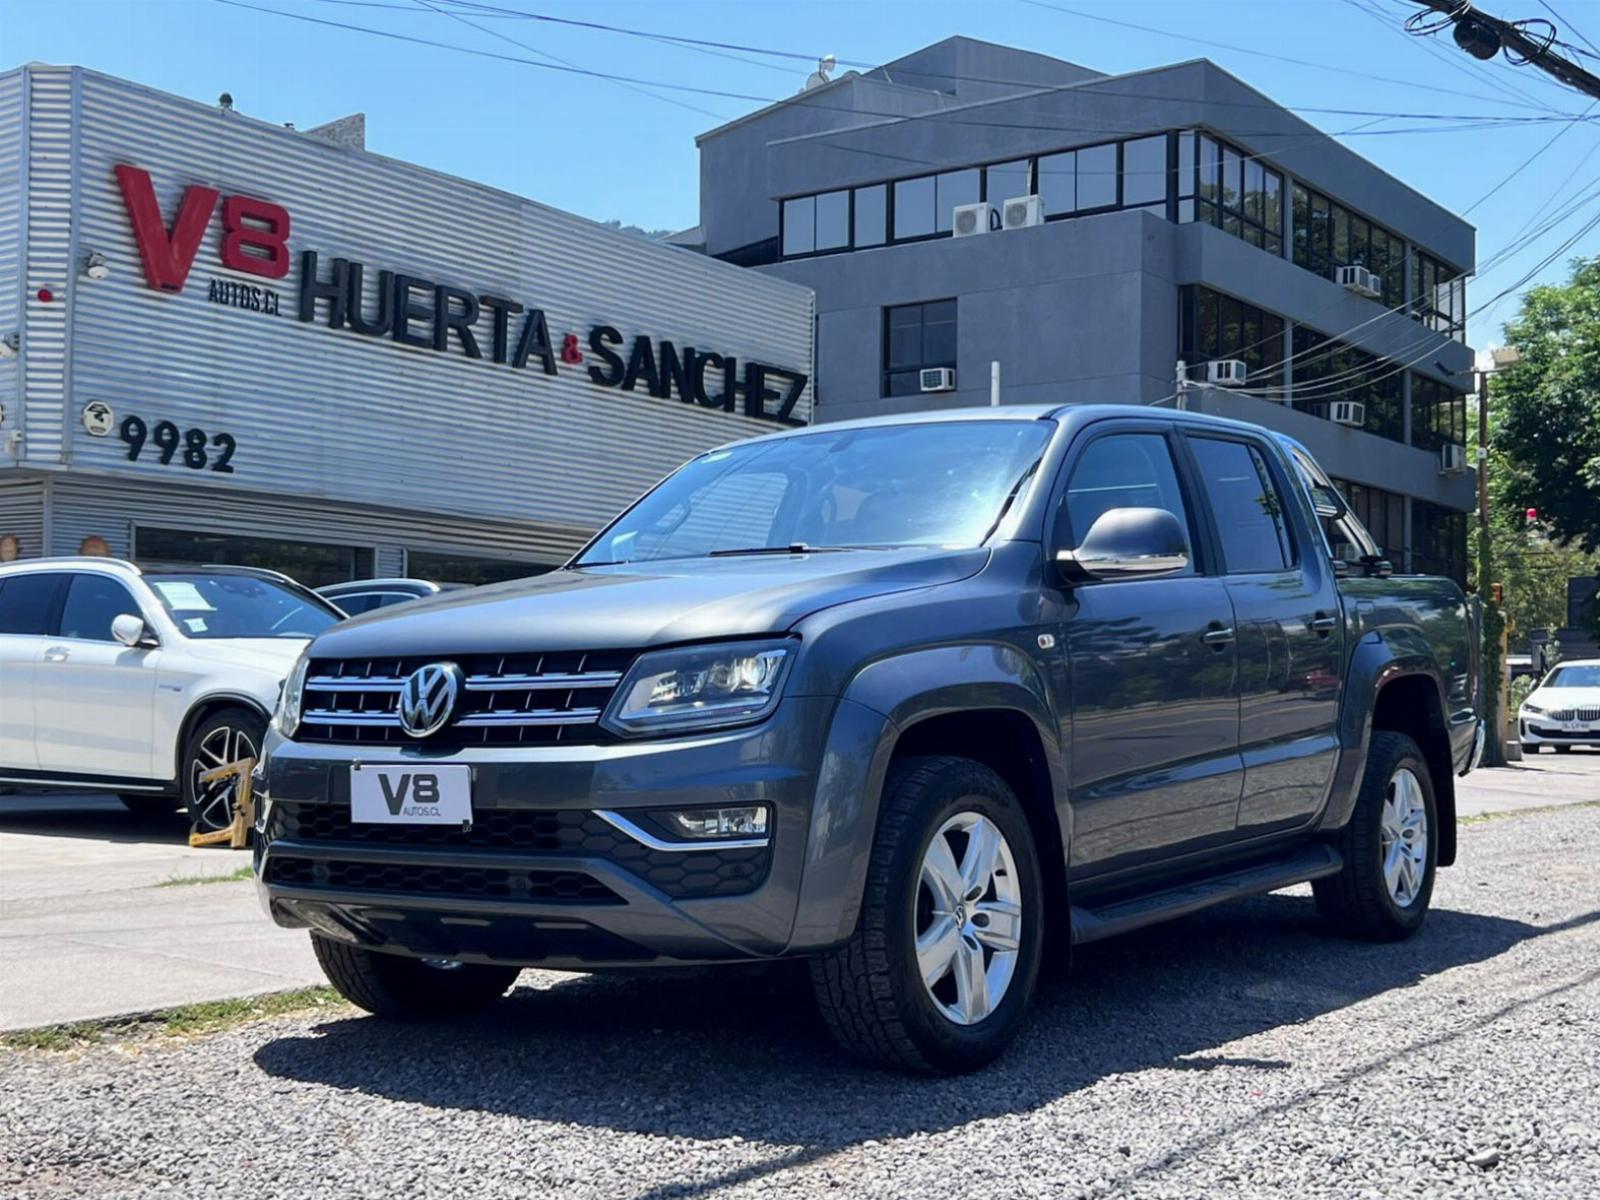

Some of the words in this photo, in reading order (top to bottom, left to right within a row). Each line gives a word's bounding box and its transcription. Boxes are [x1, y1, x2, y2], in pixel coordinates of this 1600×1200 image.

[114, 163, 291, 293] V8
[208, 279, 282, 317] AUTOS.CL
[300, 250, 558, 376] HUERTA
[561, 333, 583, 365] &
[588, 325, 808, 427] SANCHEZ
[120, 415, 237, 474] 9982
[377, 773, 440, 816] V8
[402, 805, 441, 817] AUTOS.CL
